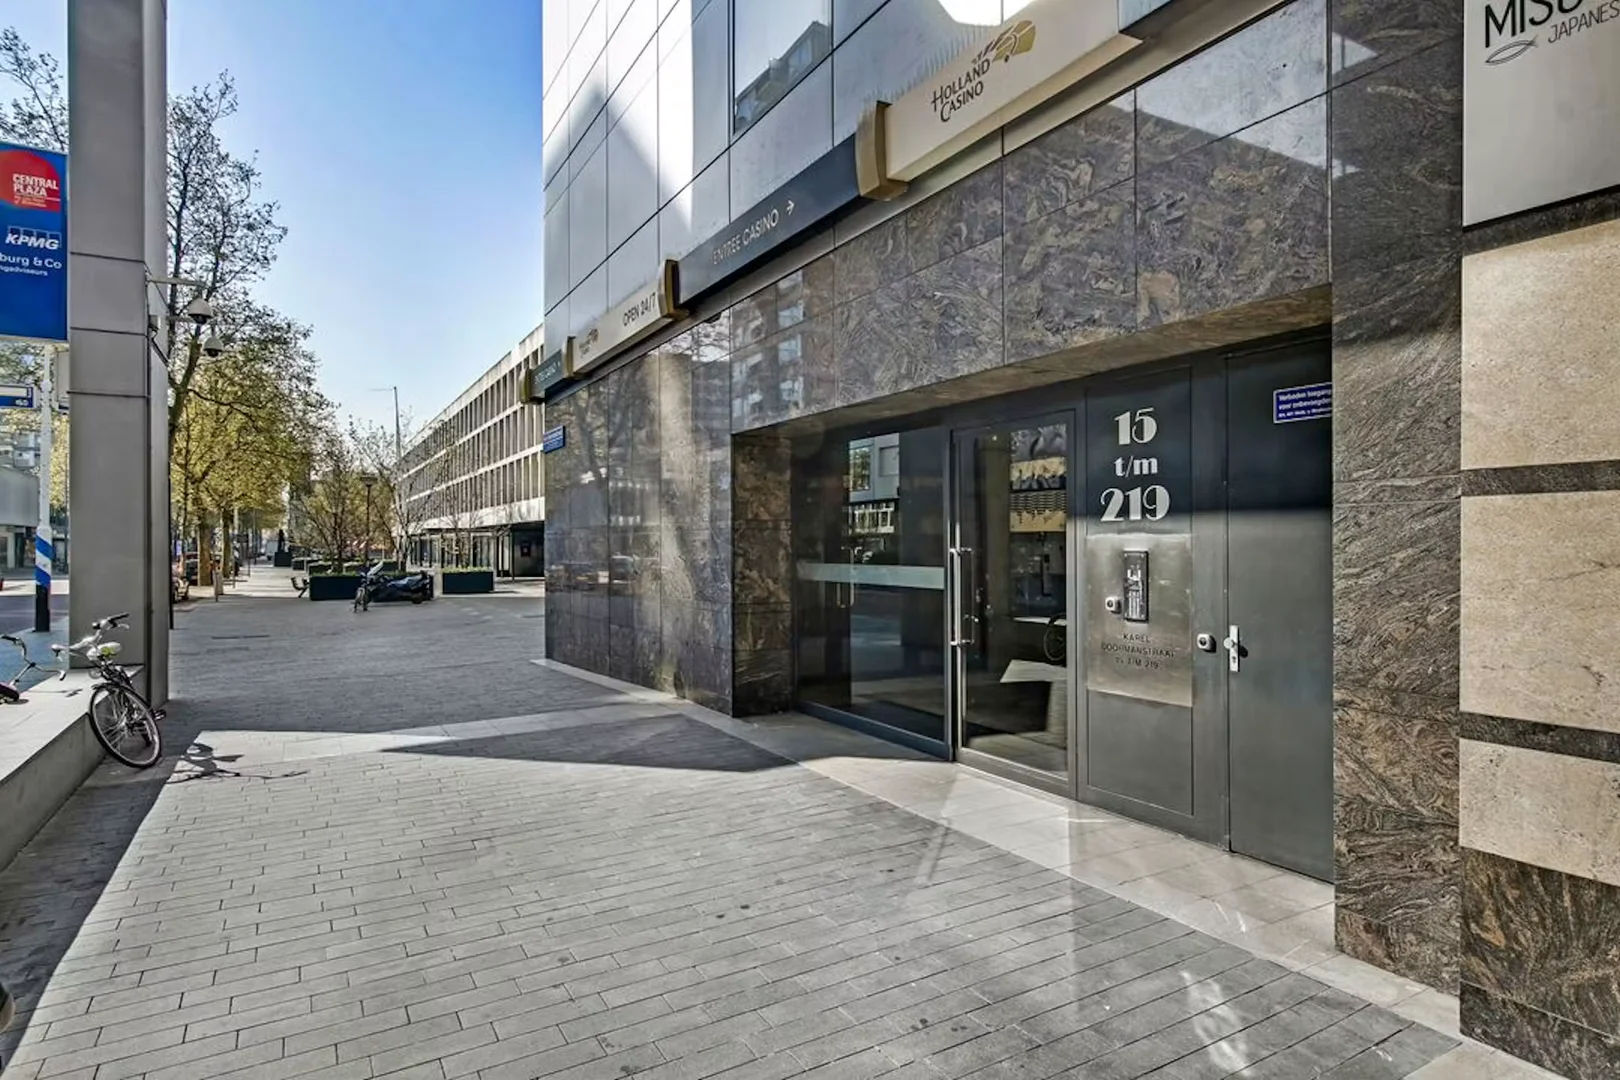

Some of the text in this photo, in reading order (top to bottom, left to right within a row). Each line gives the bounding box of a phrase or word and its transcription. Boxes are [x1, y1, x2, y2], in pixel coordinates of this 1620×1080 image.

[1548, 0, 1620, 43] JAPANES
[931, 58, 990, 112] HOLLAND
[940, 80, 983, 122] CASINO
[13, 173, 59, 190] CENTRAL
[13, 183, 47, 197] PLAZA
[5, 233, 60, 250] KPMG
[713, 208, 779, 265] ENTREE CASINO
[0, 252, 62, 269] burg & Co
[623, 291, 656, 327] OPEN 24/7
[1114, 407, 1157, 445] 15
[1114, 456, 1159, 477] t/m
[1100, 485, 1170, 522] 219
[1122, 633, 1150, 644] KAREL
[1145, 659, 1159, 669] 219
